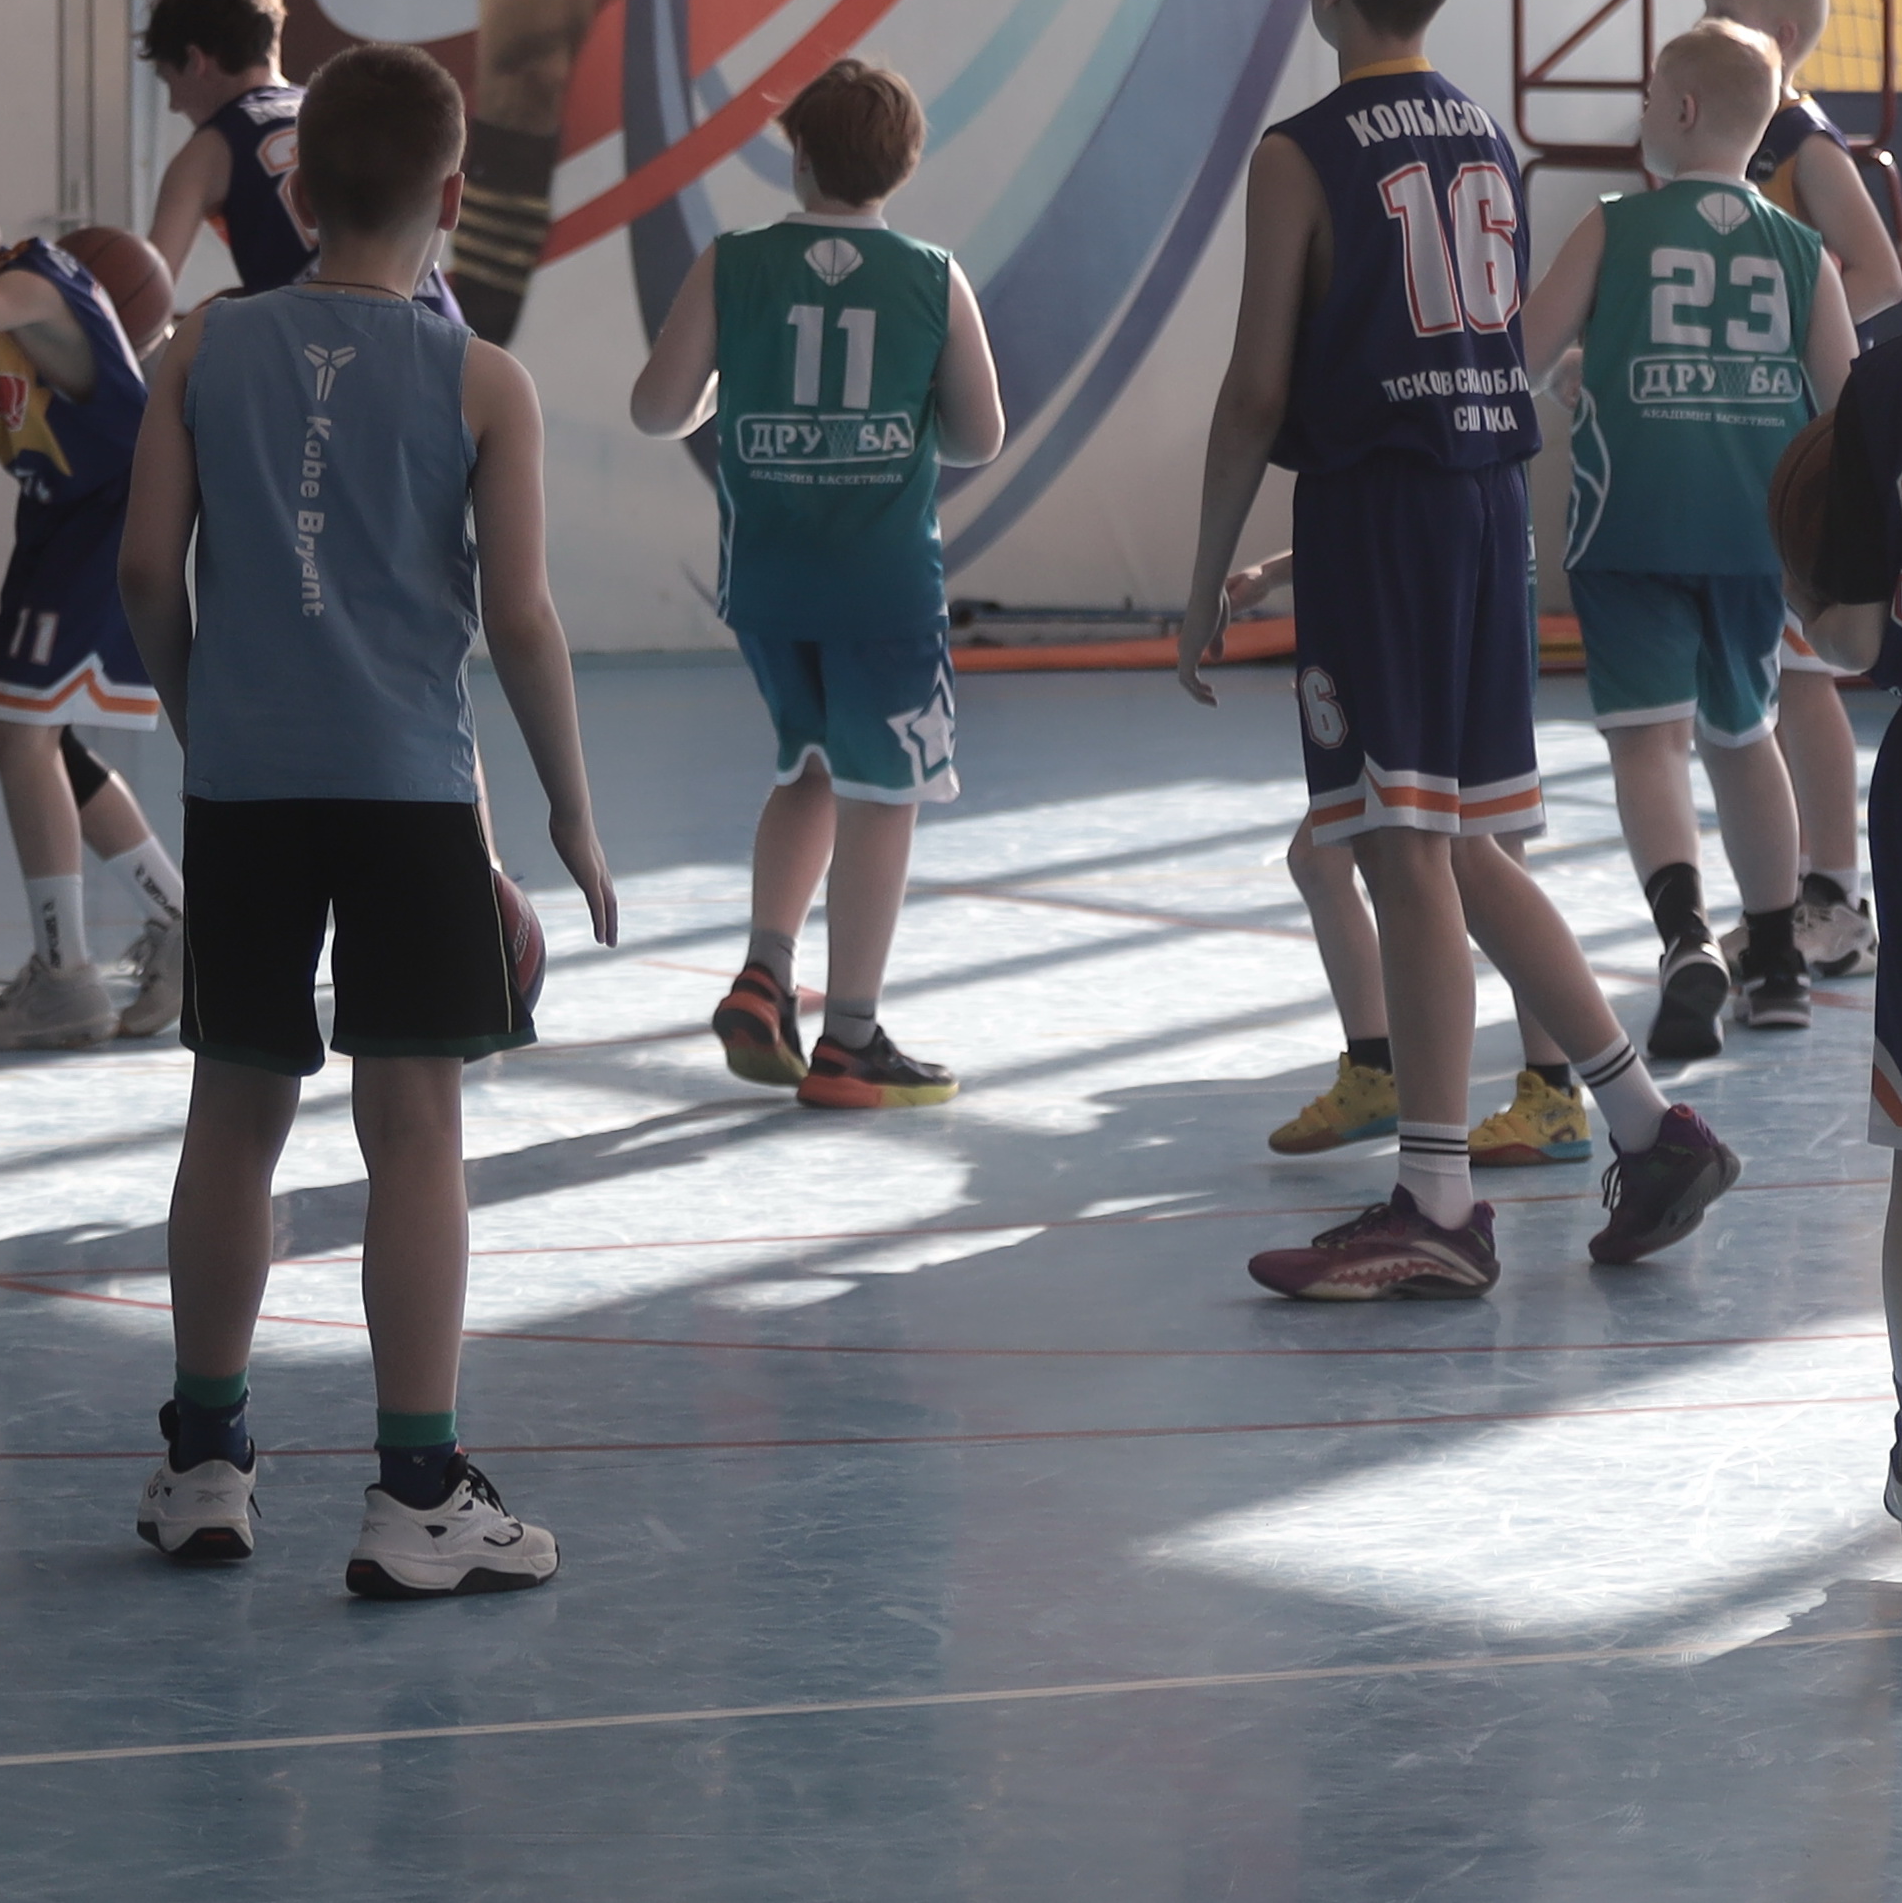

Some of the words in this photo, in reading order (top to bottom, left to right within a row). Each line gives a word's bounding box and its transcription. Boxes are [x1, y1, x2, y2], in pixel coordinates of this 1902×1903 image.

[1377, 161, 1521, 338] 16
[1651, 247, 1792, 354] 23
[786, 304, 876, 410] 11
[1639, 362, 1797, 398] ДРУБА
[300, 416, 332, 498] Kobe
[749, 423, 911, 458] ДРУБА
[295, 509, 326, 617] Bryant
[1300, 666, 1349, 749] 6
